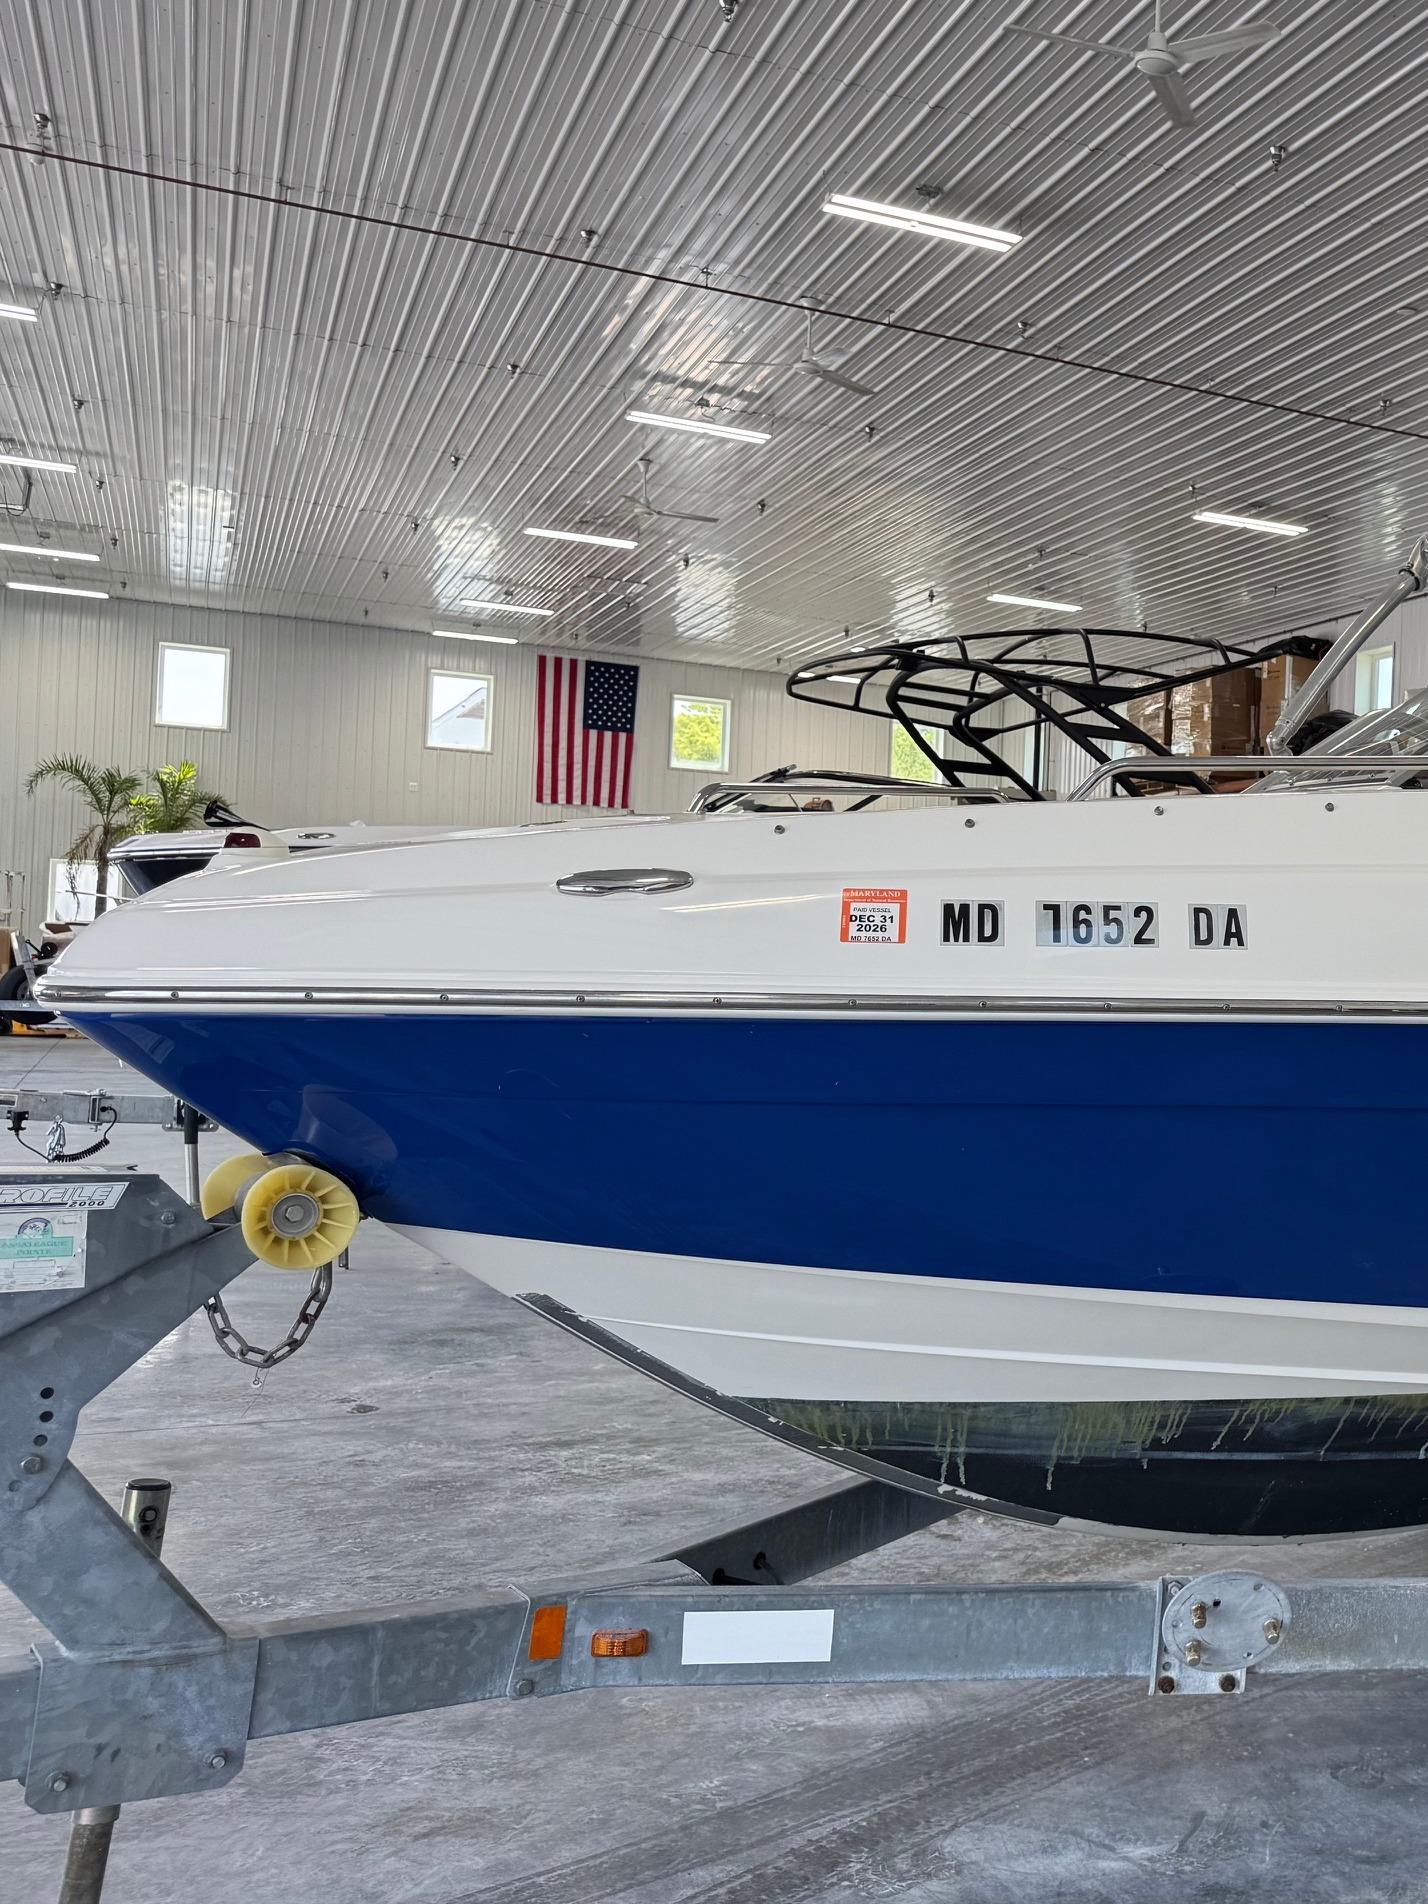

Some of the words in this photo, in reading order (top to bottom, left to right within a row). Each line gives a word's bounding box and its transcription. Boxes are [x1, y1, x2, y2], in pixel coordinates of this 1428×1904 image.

[850, 889, 901, 897] MARYLAND
[849, 914, 876, 923] DEC
[880, 915, 894, 924] 31
[856, 923, 888, 933] 2026
[943, 903, 999, 943] MD
[1193, 907, 1245, 947] DA
[68, 1200, 105, 1208] 2000
